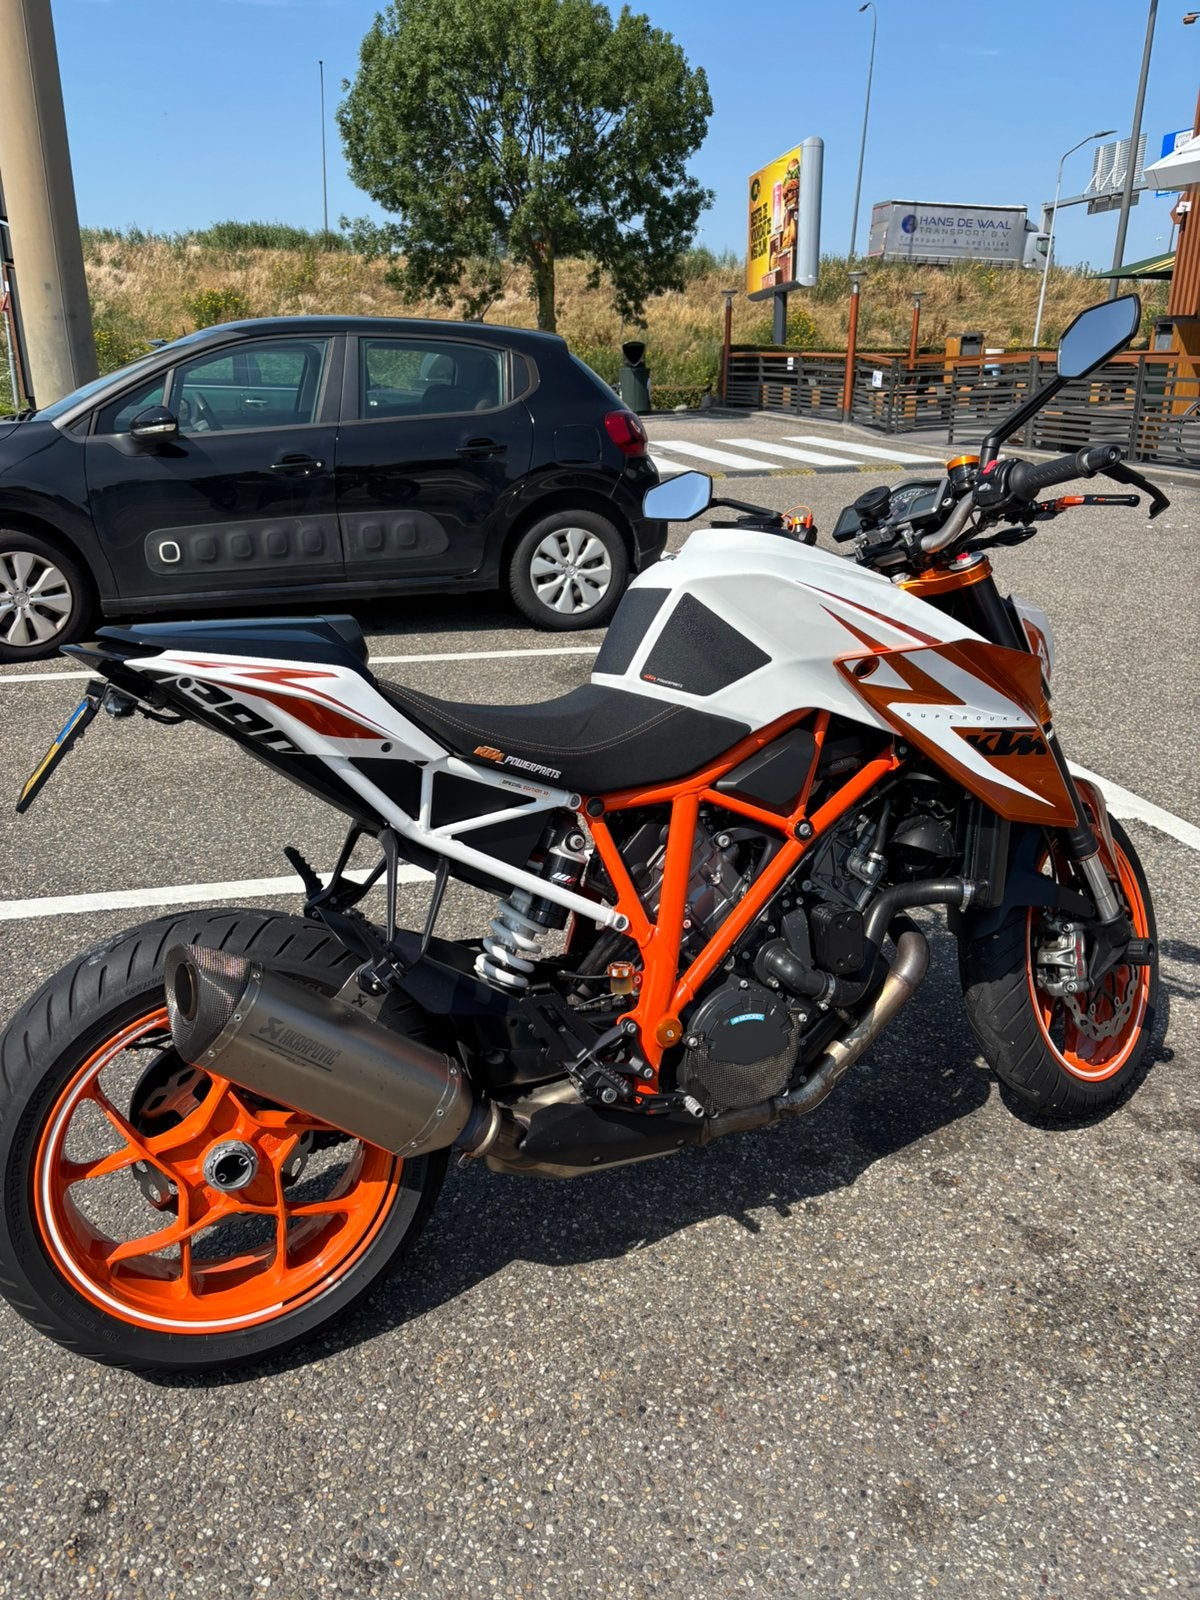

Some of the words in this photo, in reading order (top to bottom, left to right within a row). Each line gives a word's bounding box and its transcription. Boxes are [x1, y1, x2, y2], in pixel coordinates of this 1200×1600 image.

[919, 216, 954, 227] HANS
[957, 218, 973, 228] DE
[977, 219, 1012, 230] WAAL
[919, 227, 986, 237] TRANSPORT
[965, 729, 1050, 756] KTM
[504, 755, 562, 779] POWERPARTS
